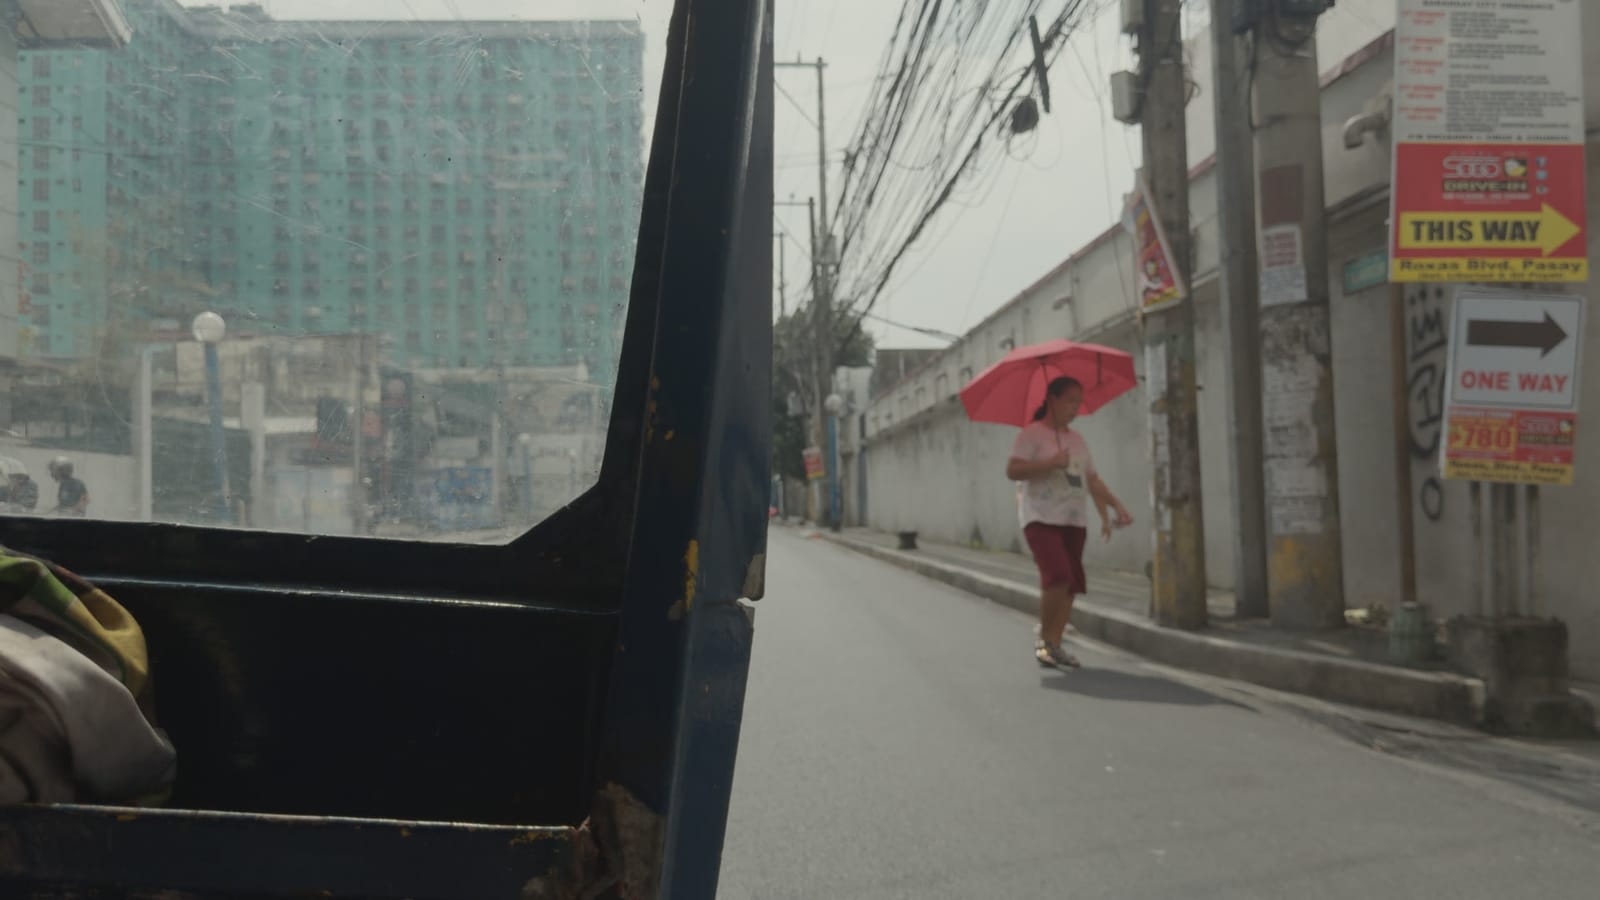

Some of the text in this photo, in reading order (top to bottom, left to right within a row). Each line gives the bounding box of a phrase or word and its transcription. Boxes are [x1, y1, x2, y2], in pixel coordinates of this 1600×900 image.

[1443, 181, 1528, 192] DRIVE-IN
[1410, 220, 1541, 241] THIS WAY
[1400, 259, 1459, 271] Roxas
[1523, 259, 1582, 273] Pasay
[1460, 370, 1568, 394] ONE WAY
